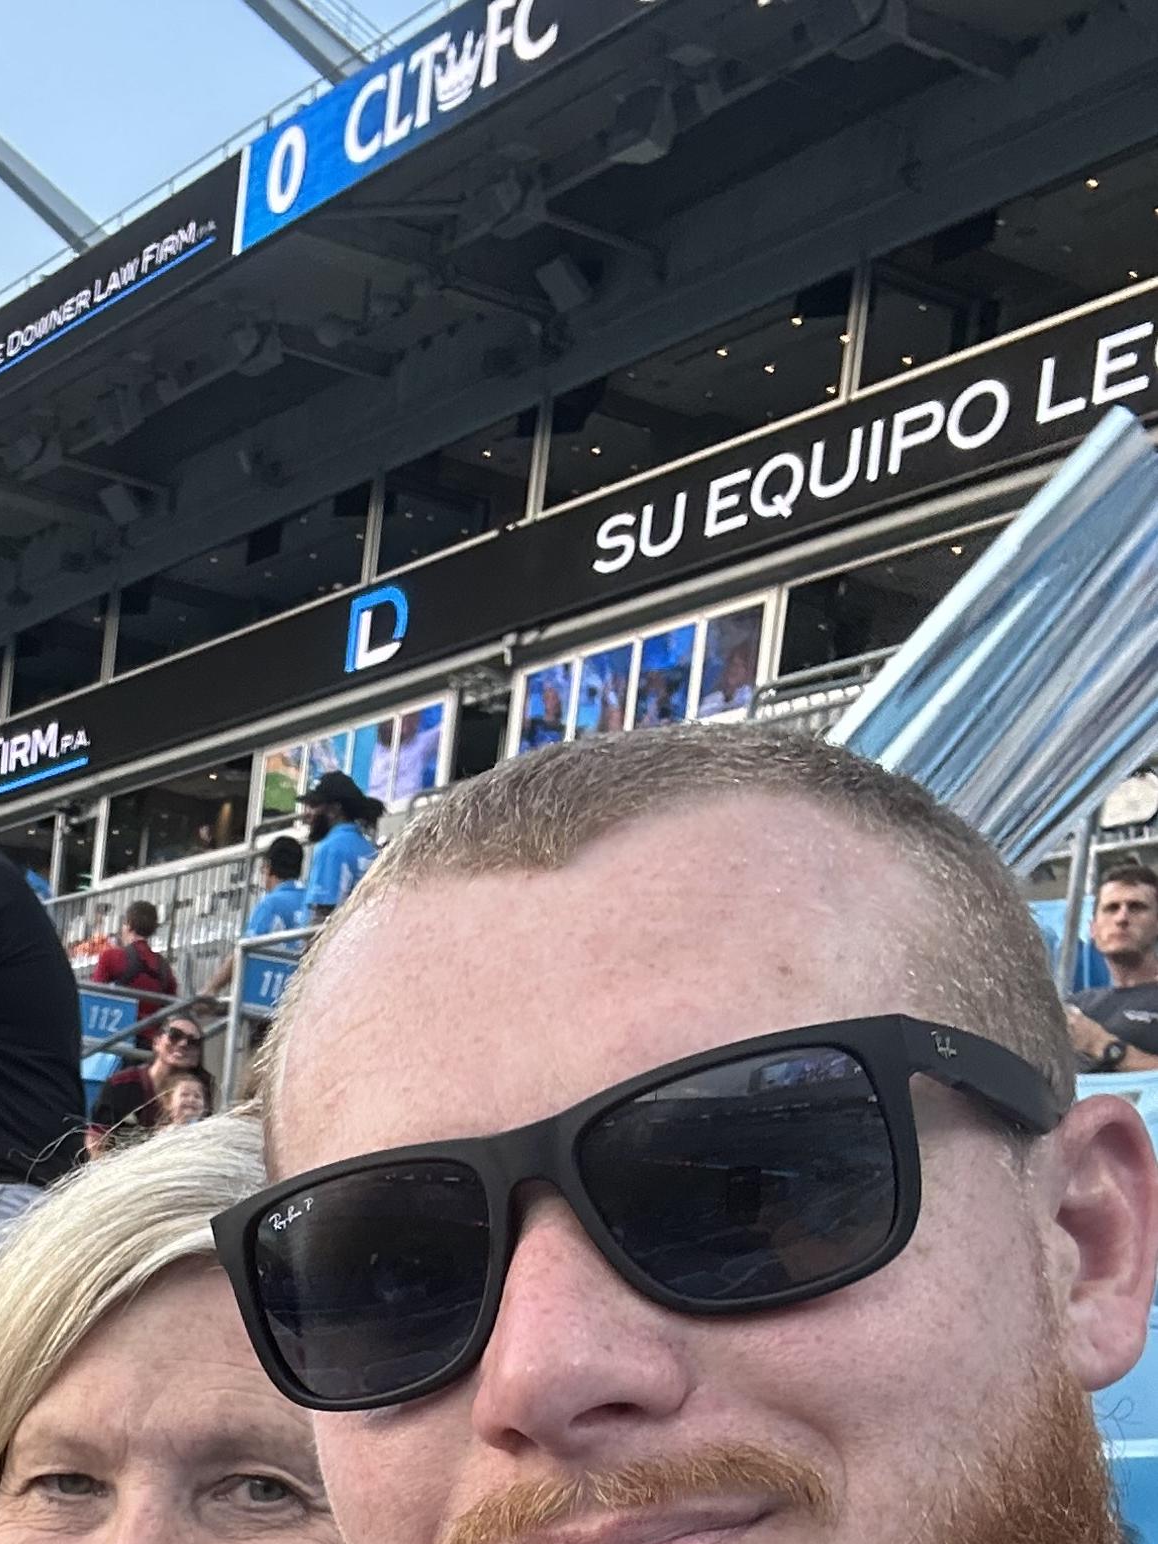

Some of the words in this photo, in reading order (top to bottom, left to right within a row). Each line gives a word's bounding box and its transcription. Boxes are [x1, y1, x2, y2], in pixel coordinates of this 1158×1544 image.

[344, 31, 451, 163] CLT
[479, 0, 558, 88] FC
[6, 289, 92, 357] DOWNER
[93, 256, 140, 303] LAW
[141, 220, 197, 274] FIRM
[592, 491, 687, 574] SU
[704, 378, 1010, 538] EQUIPO
[1035, 320, 1158, 425] LE
